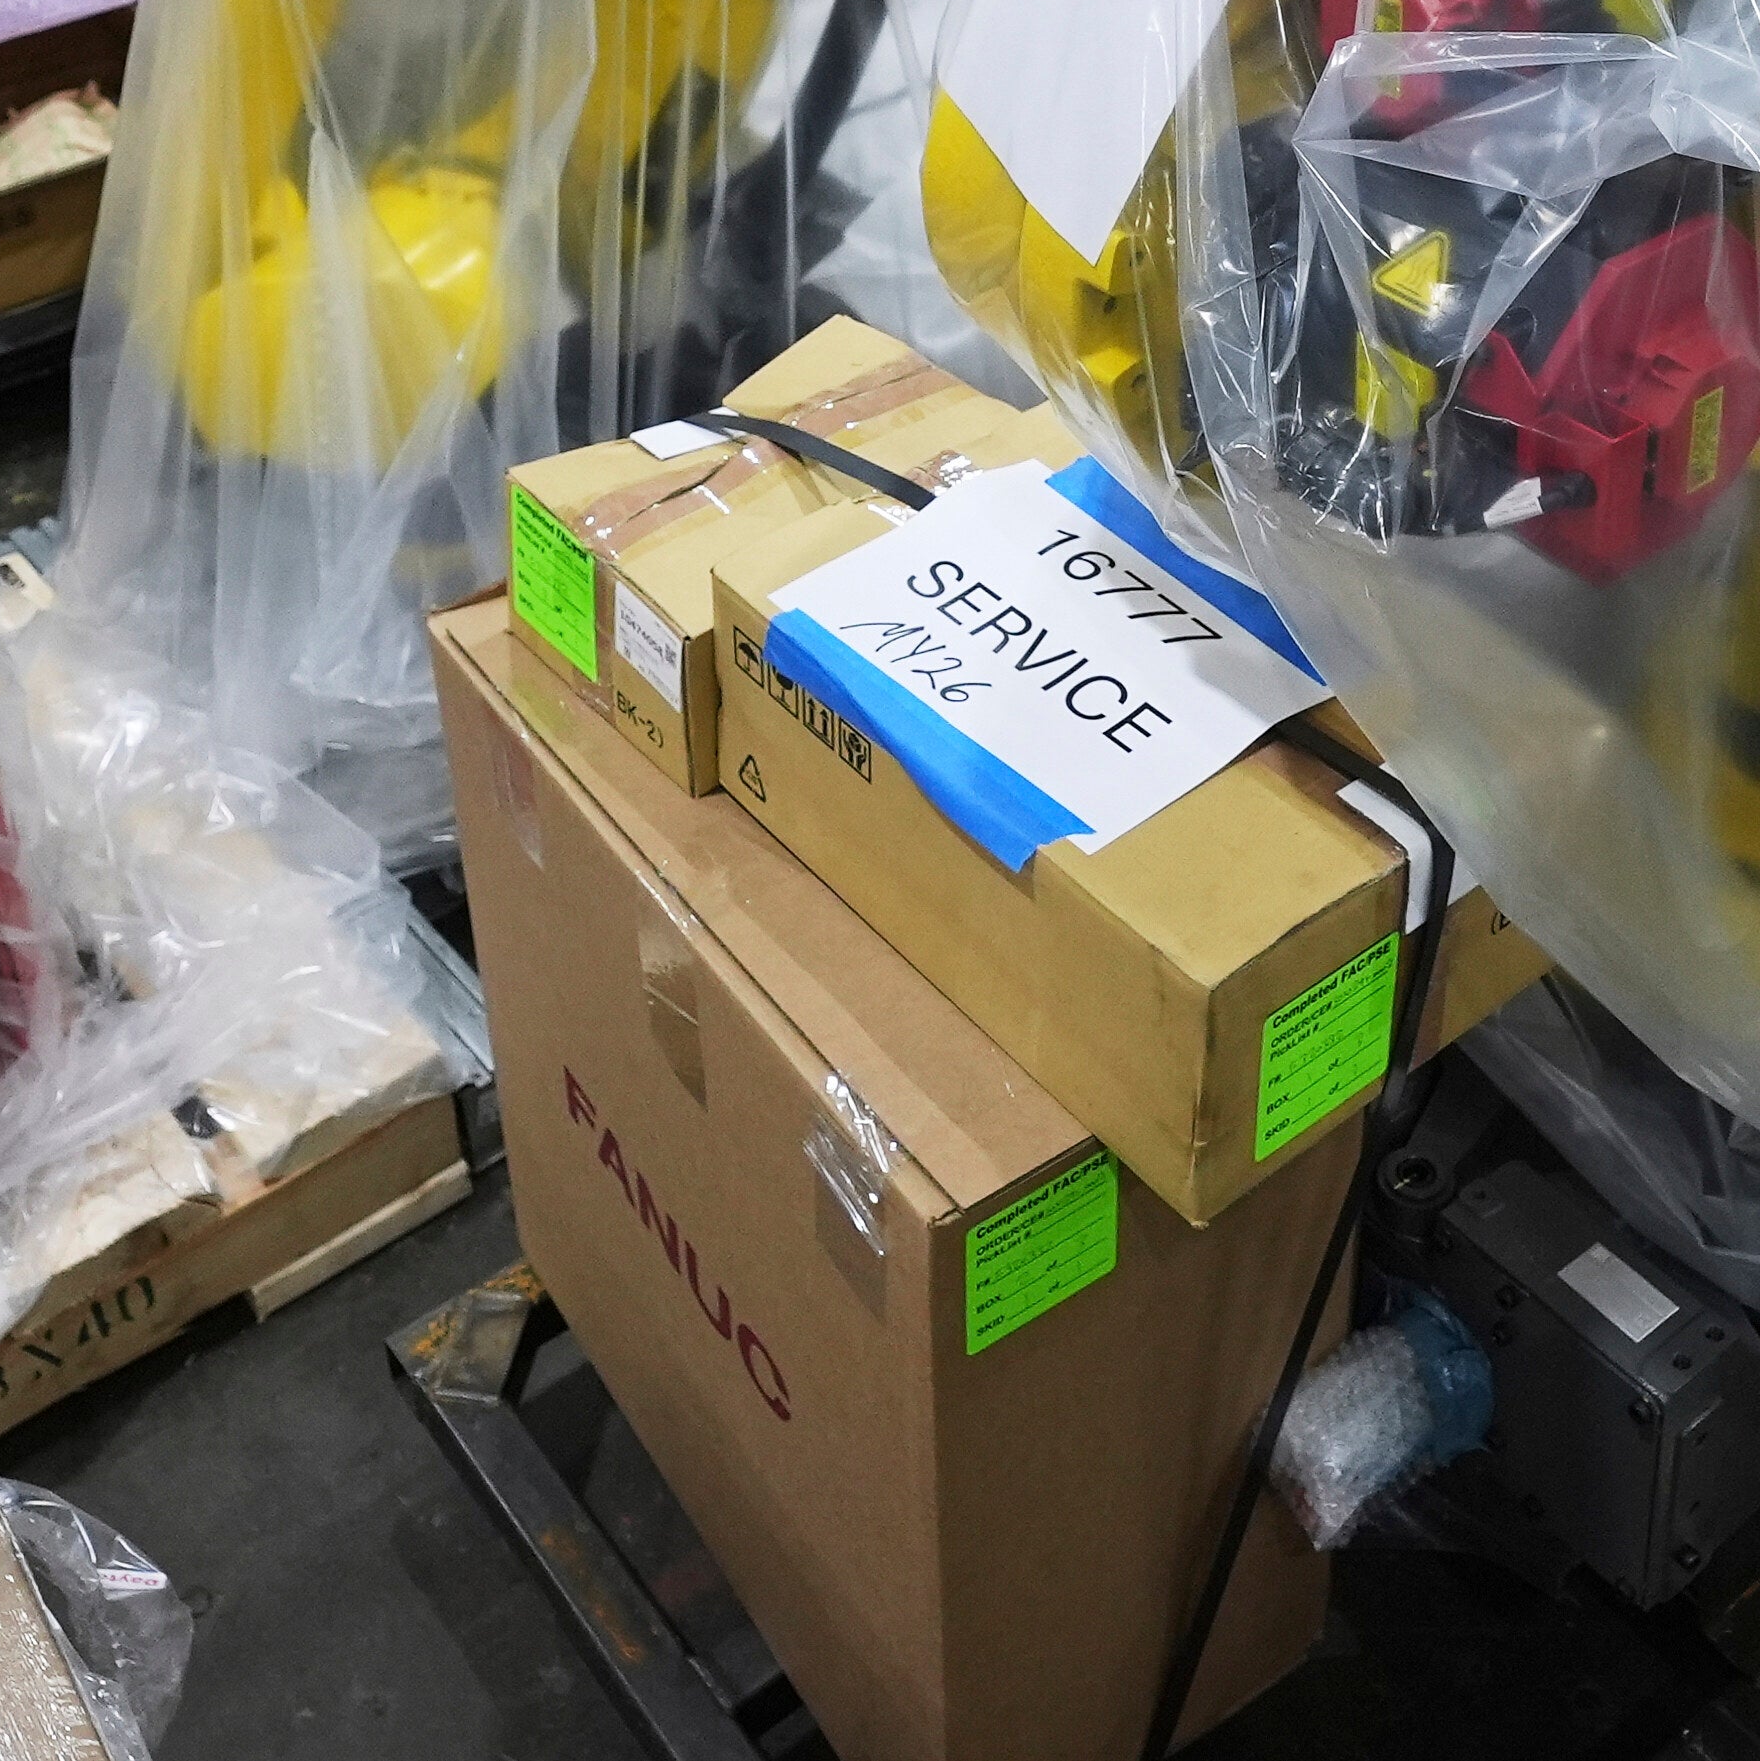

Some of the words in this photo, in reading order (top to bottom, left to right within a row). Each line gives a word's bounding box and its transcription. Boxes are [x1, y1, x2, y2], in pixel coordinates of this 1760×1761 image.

[1036, 529, 1222, 645] 16777
[839, 621, 992, 704] MY26
[906, 560, 1172, 754] SERVICE
[1272, 977, 1339, 1029] Completed
[1264, 1117, 1291, 1142] SKID
[1266, 1092, 1291, 1115] BOX
[563, 1065, 792, 1422] FANUC
[975, 1189, 1049, 1240] Completed
